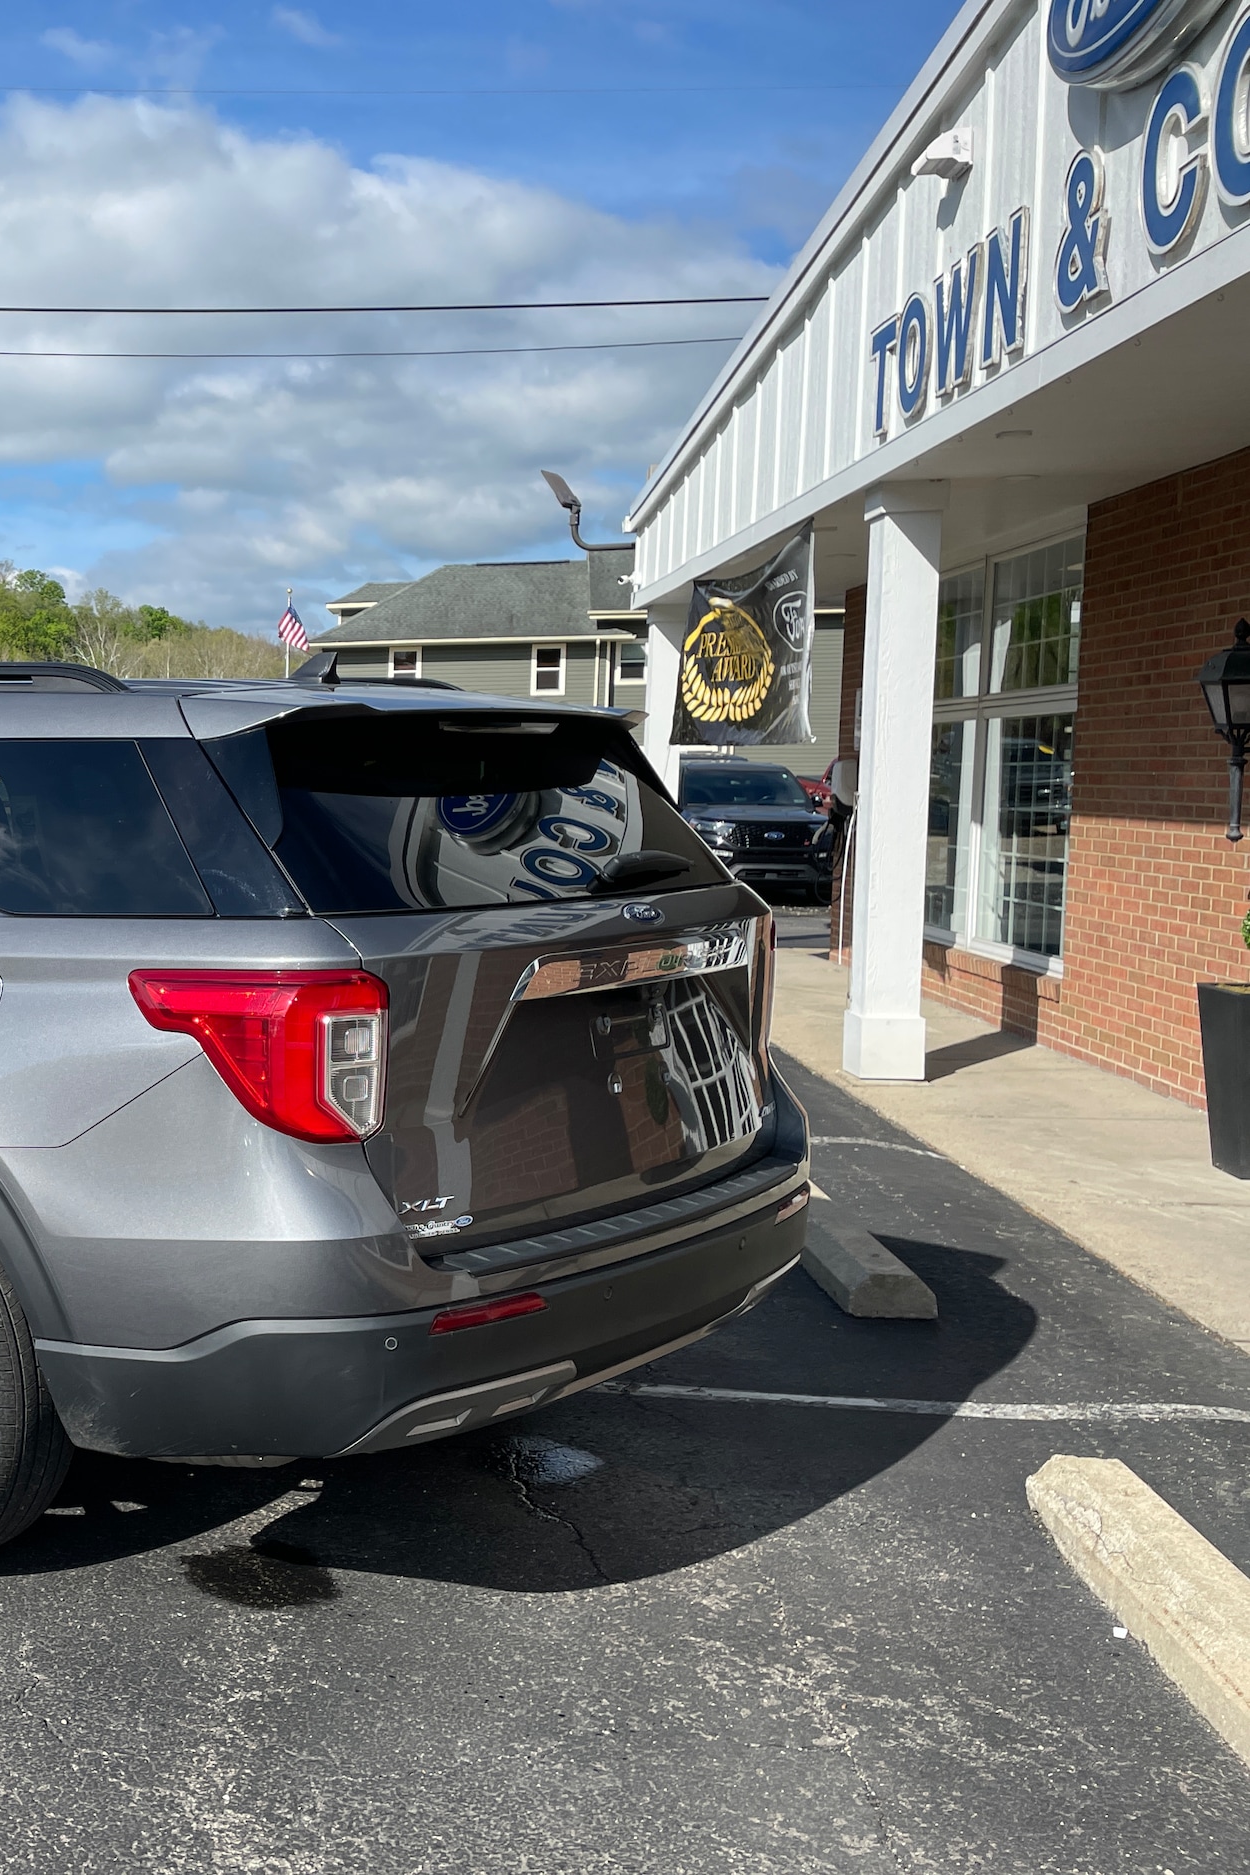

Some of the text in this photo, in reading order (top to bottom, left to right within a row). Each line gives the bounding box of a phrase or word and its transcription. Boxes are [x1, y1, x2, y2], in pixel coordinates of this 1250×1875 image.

[870, 206, 1027, 438] TOWN
[1054, 148, 1108, 314] &
[711, 655, 756, 682] AWARD
[579, 945, 727, 980] EXPLORER
[399, 1195, 455, 1215] XLT
